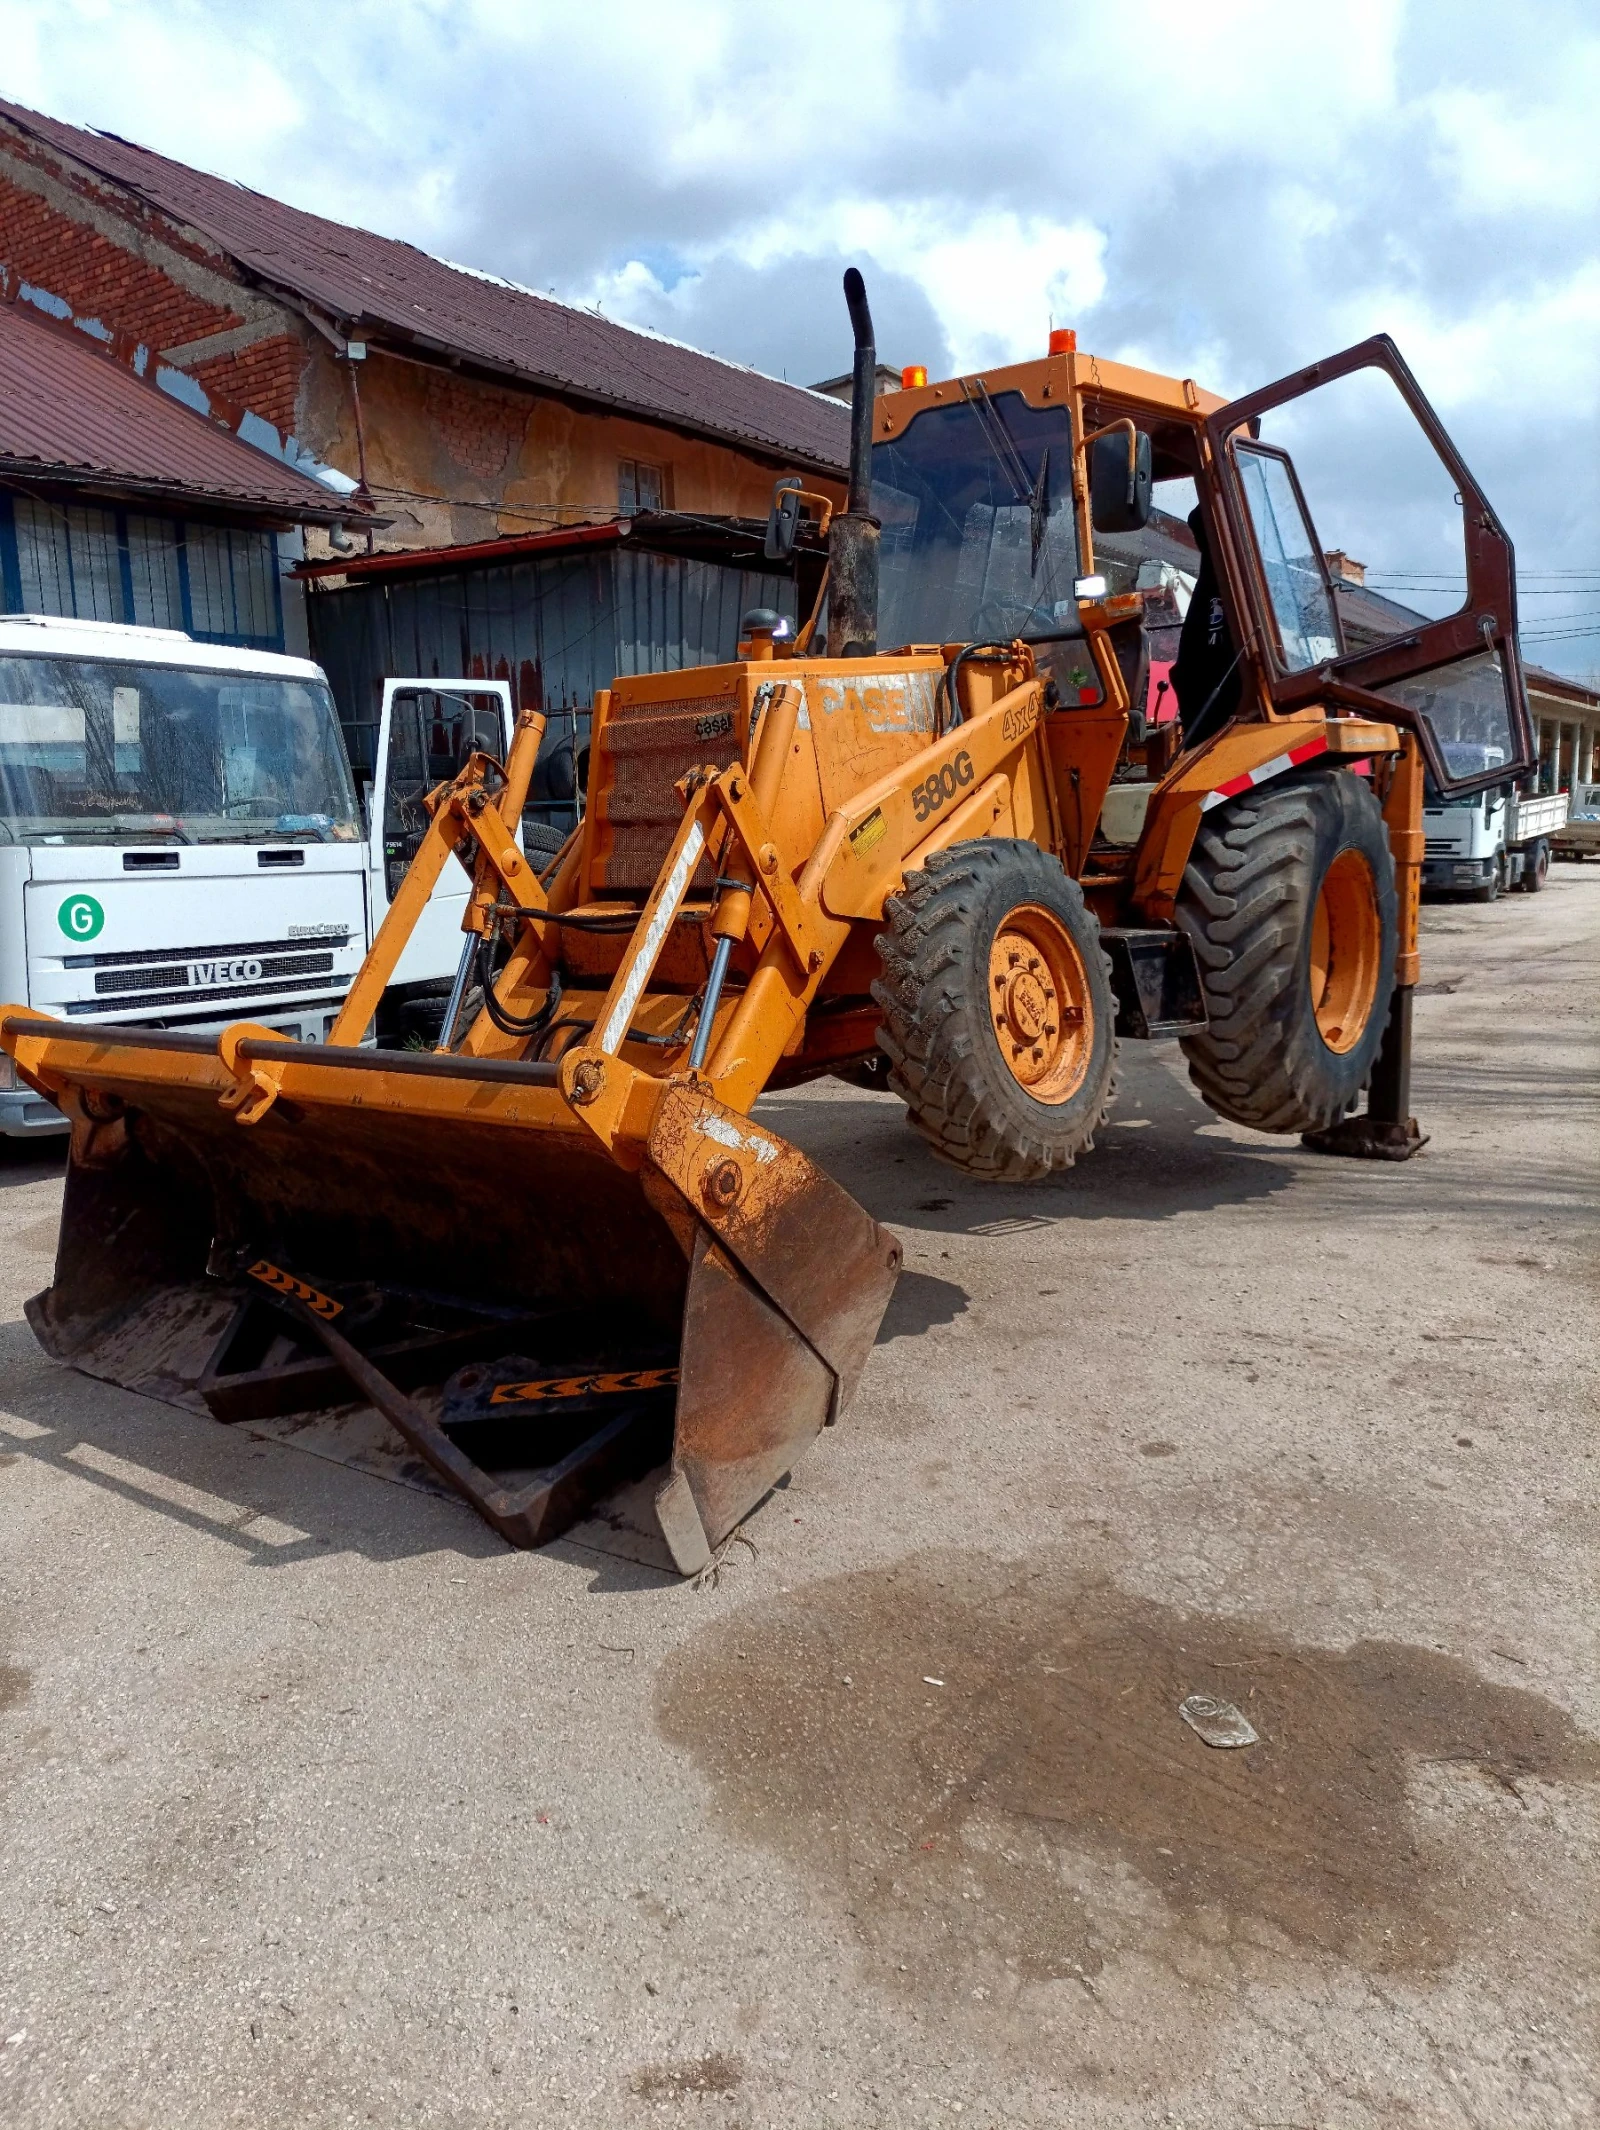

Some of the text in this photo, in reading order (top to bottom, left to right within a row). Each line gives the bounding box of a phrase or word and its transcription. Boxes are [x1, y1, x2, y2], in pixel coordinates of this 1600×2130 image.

[1002, 691, 1040, 742] 4x4
[911, 750, 975, 822] 580G
[187, 960, 263, 986] IVECO
